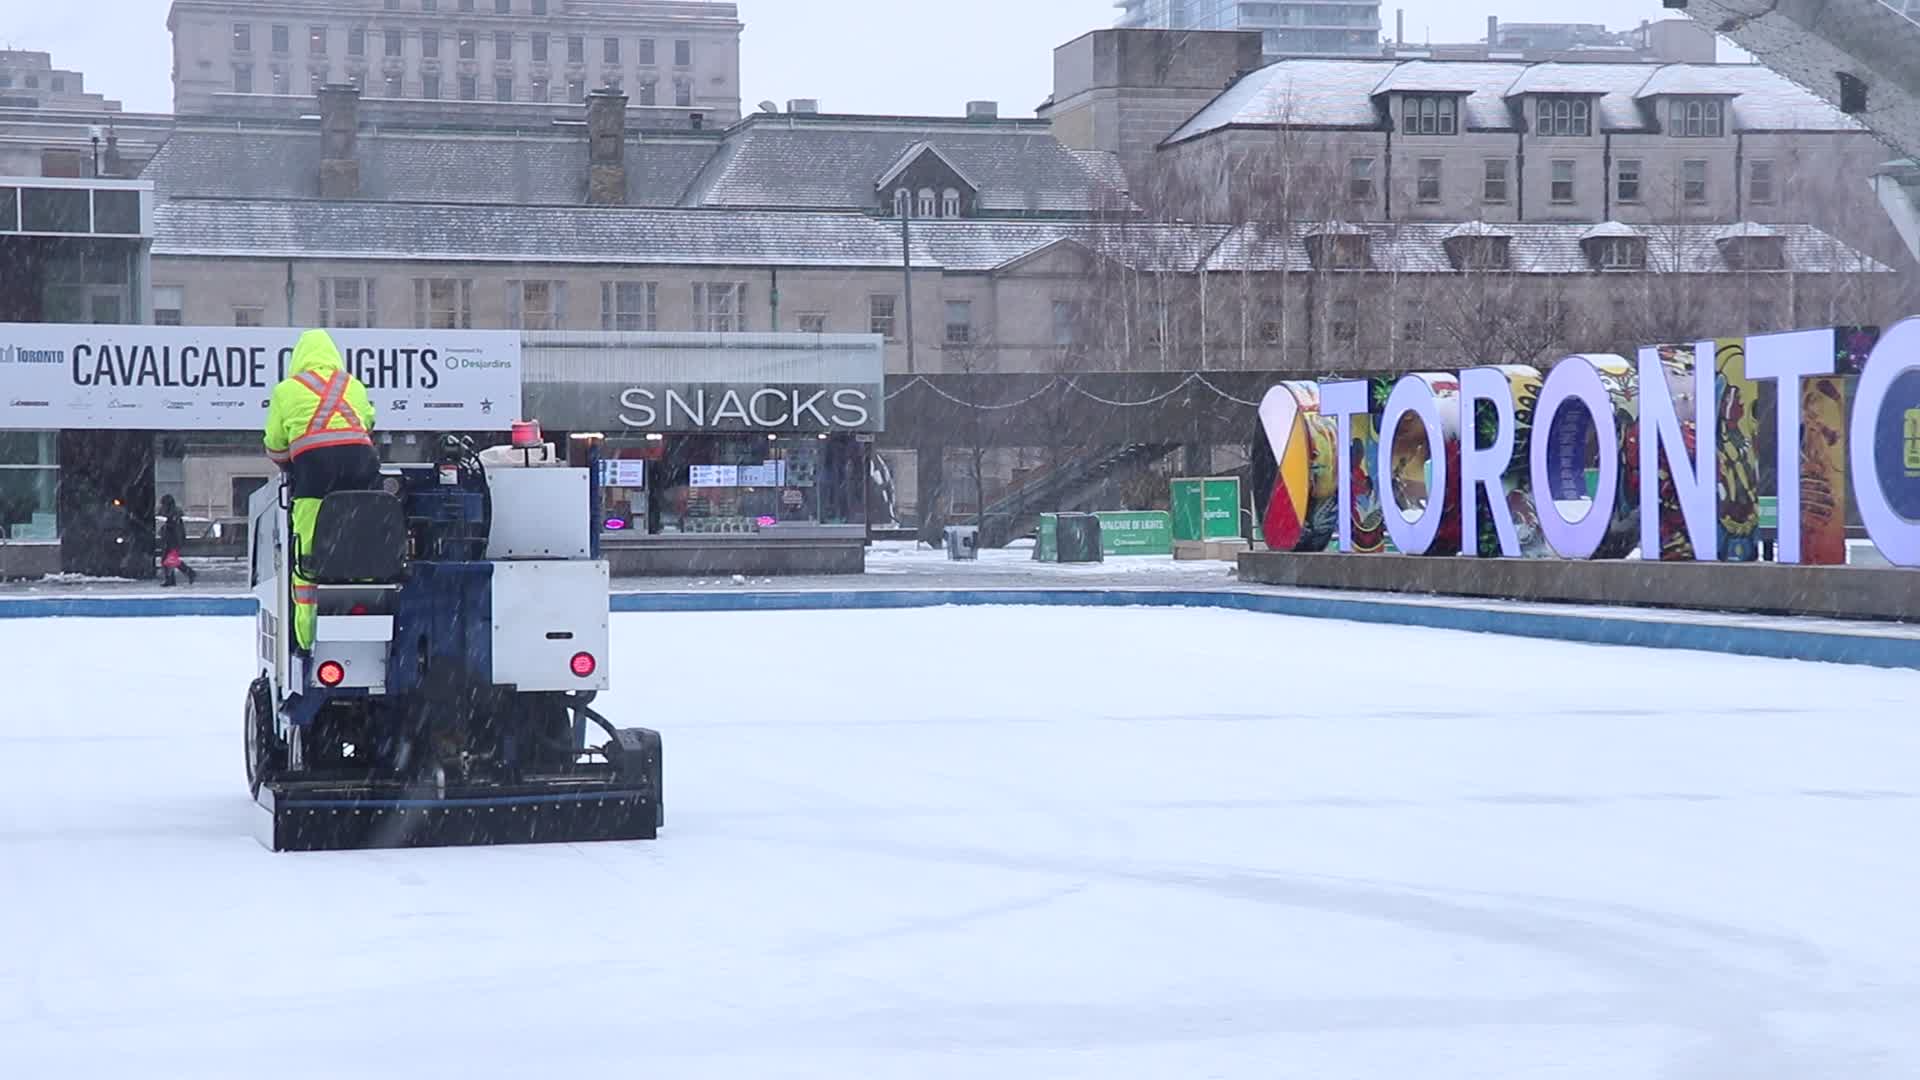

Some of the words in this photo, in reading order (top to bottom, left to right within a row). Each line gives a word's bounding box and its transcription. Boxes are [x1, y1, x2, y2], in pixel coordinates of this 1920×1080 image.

[16, 346, 64, 364] TORONTO
[72, 344, 266, 388] CAVALCADE
[277, 347, 295, 385] O
[346, 348, 438, 389] IGHTS
[461, 359, 512, 370] Desjardins
[618, 388, 869, 427] SNACKS
